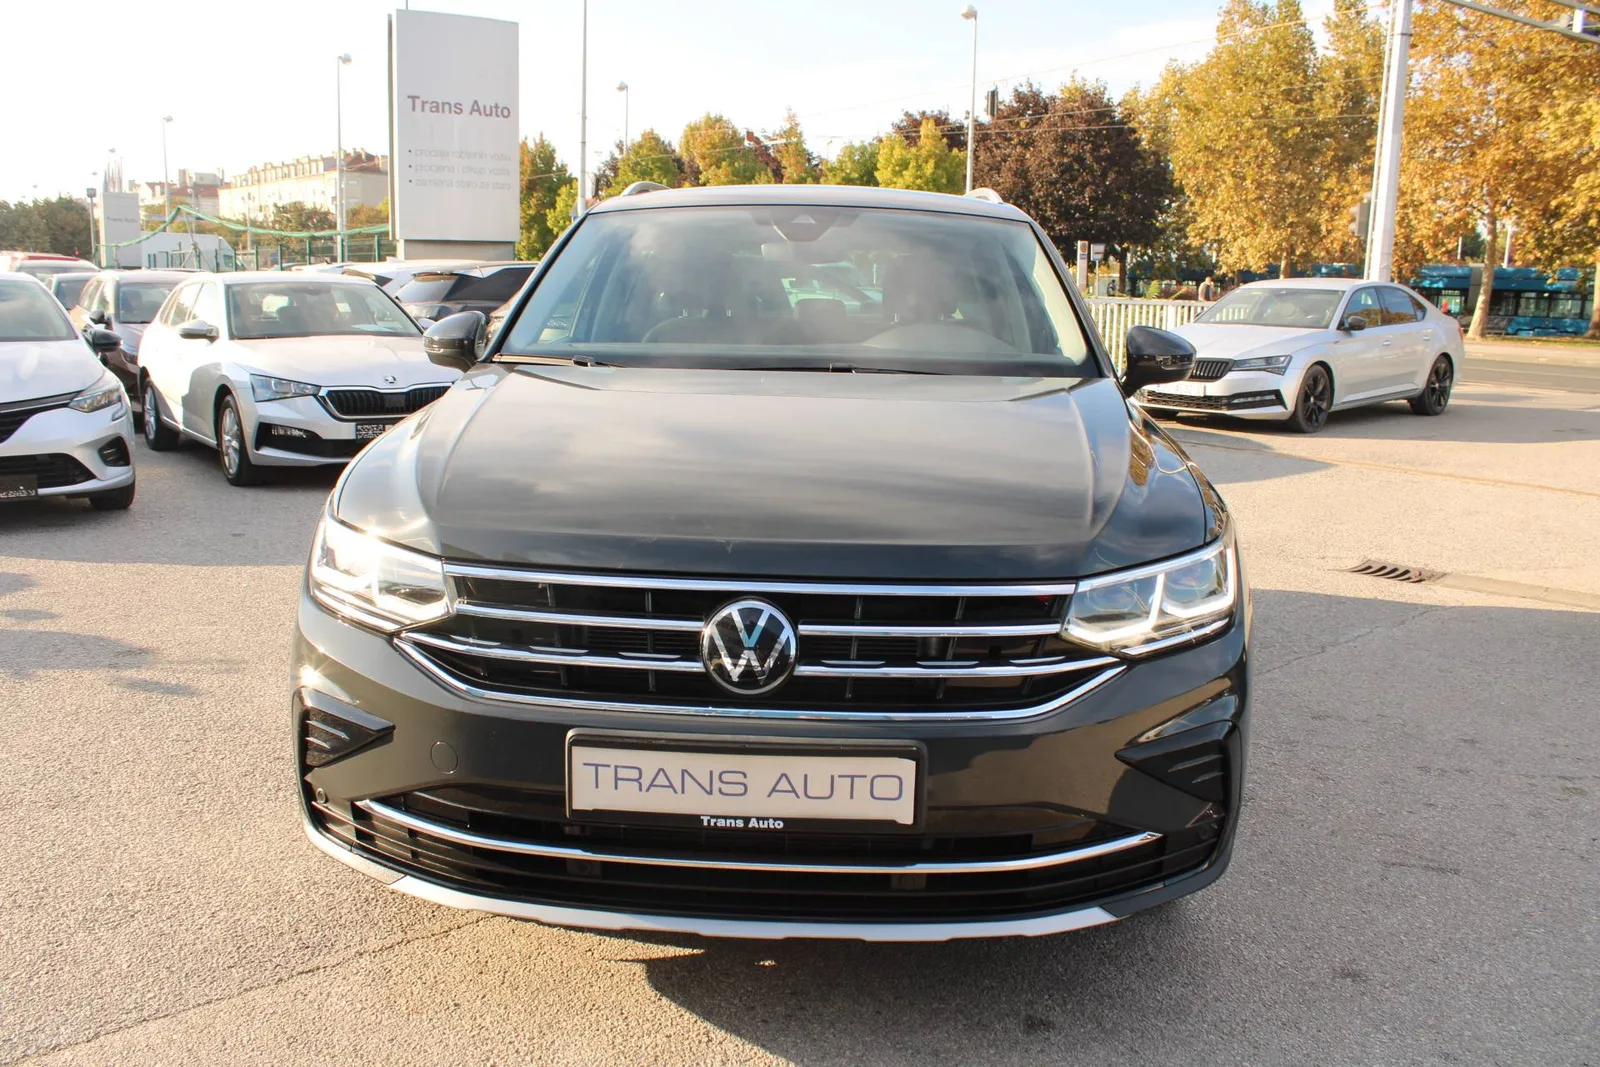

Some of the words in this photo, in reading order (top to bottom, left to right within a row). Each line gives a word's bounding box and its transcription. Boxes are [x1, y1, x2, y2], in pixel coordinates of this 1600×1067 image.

[407, 95, 464, 115] Trans
[469, 99, 512, 119] Auto
[583, 763, 748, 796] TRANS
[767, 773, 904, 801] AUTO
[701, 815, 744, 828] Trans
[748, 817, 784, 829] Auto
